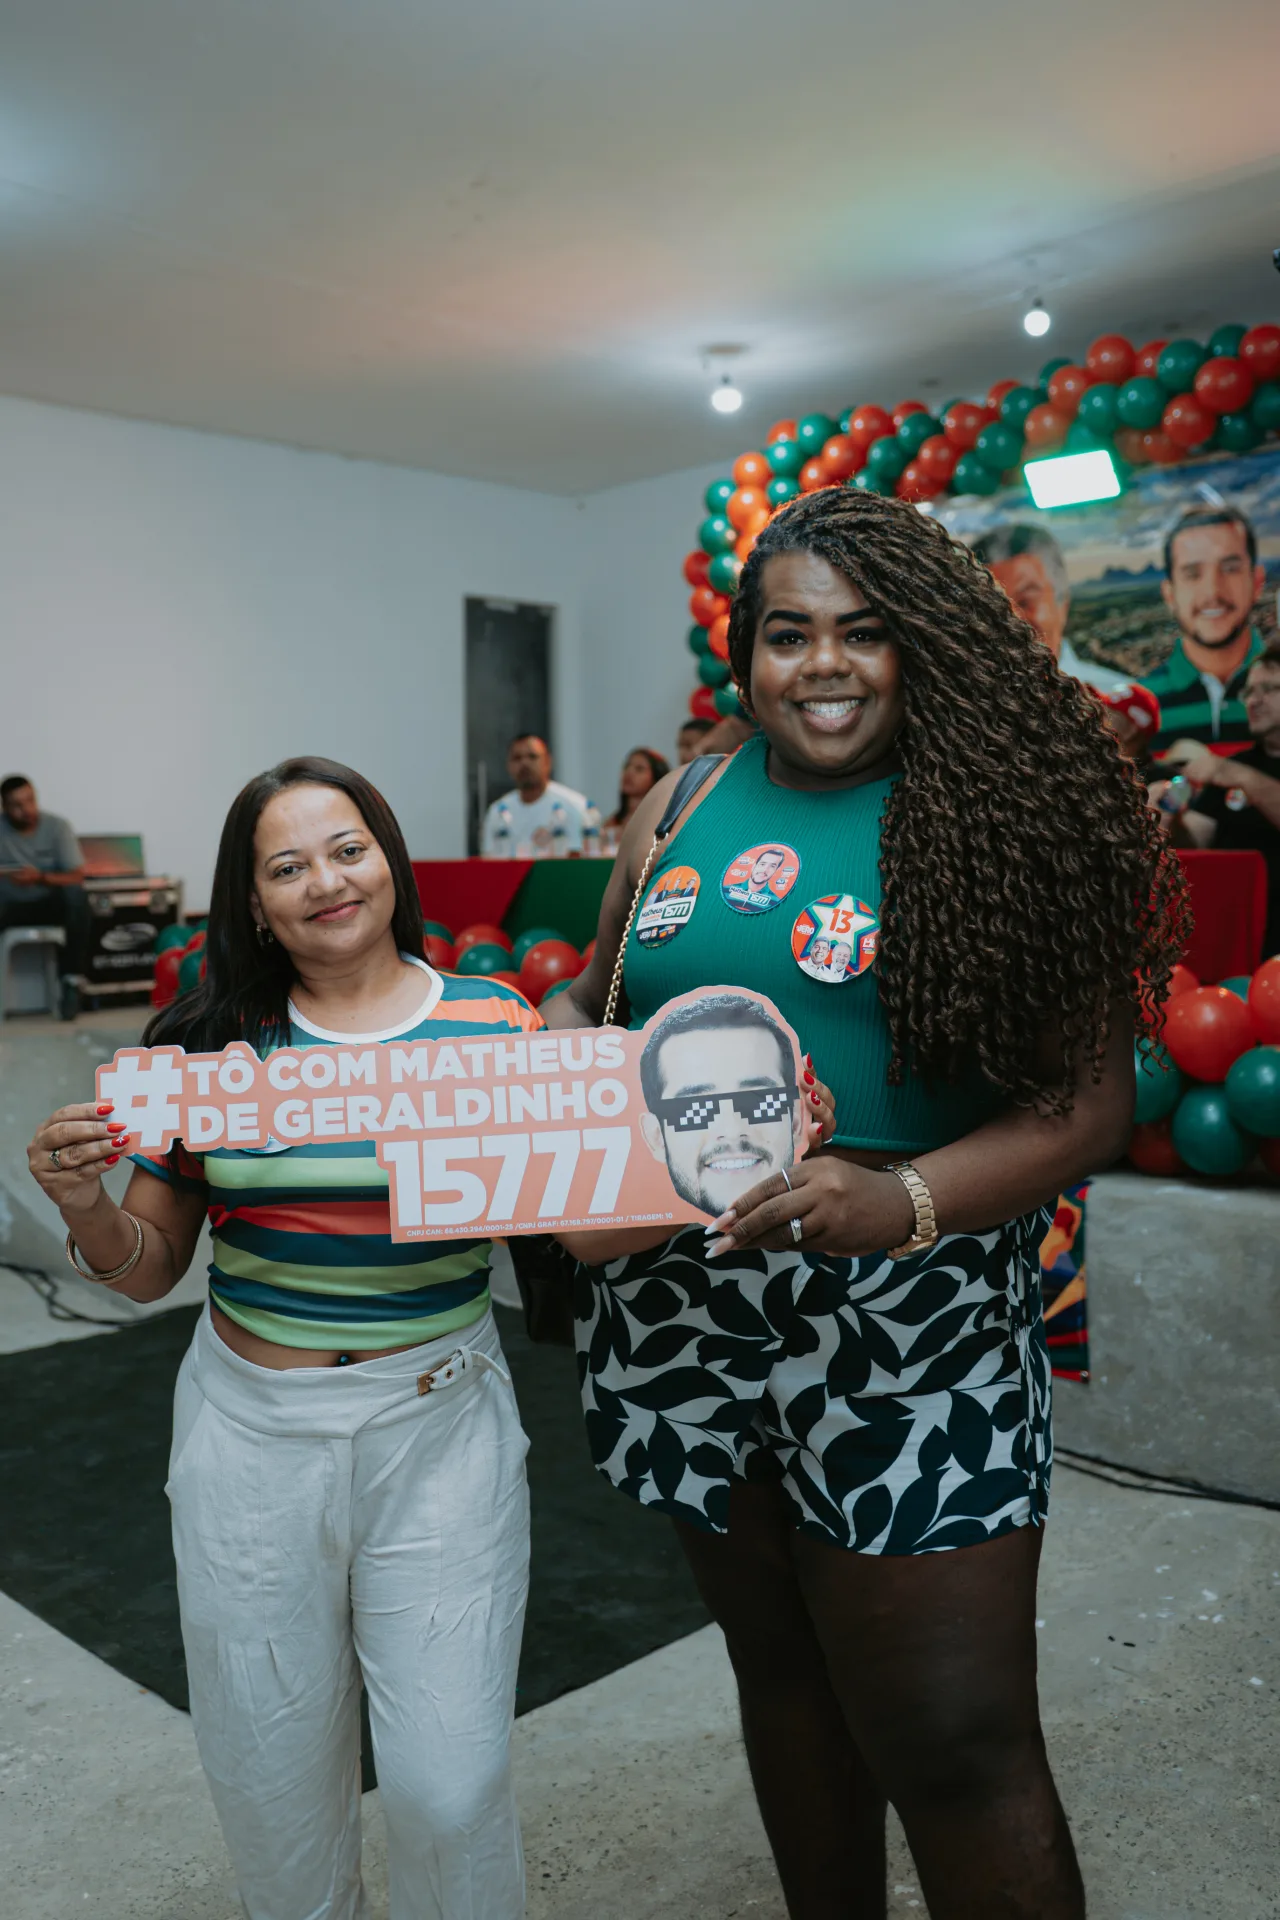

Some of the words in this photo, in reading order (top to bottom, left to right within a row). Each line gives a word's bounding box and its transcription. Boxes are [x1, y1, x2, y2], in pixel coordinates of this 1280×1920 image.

[829, 908, 854, 933] 13
[267, 1050, 377, 1091] COM
[390, 1034, 626, 1083] MATHEUS
[188, 1102, 260, 1144] DE
[273, 1078, 629, 1139] GERALDINHO
[383, 1126, 632, 1227] 15777
[406, 1229, 424, 1237] CNPJ
[426, 1228, 443, 1236] CAN:
